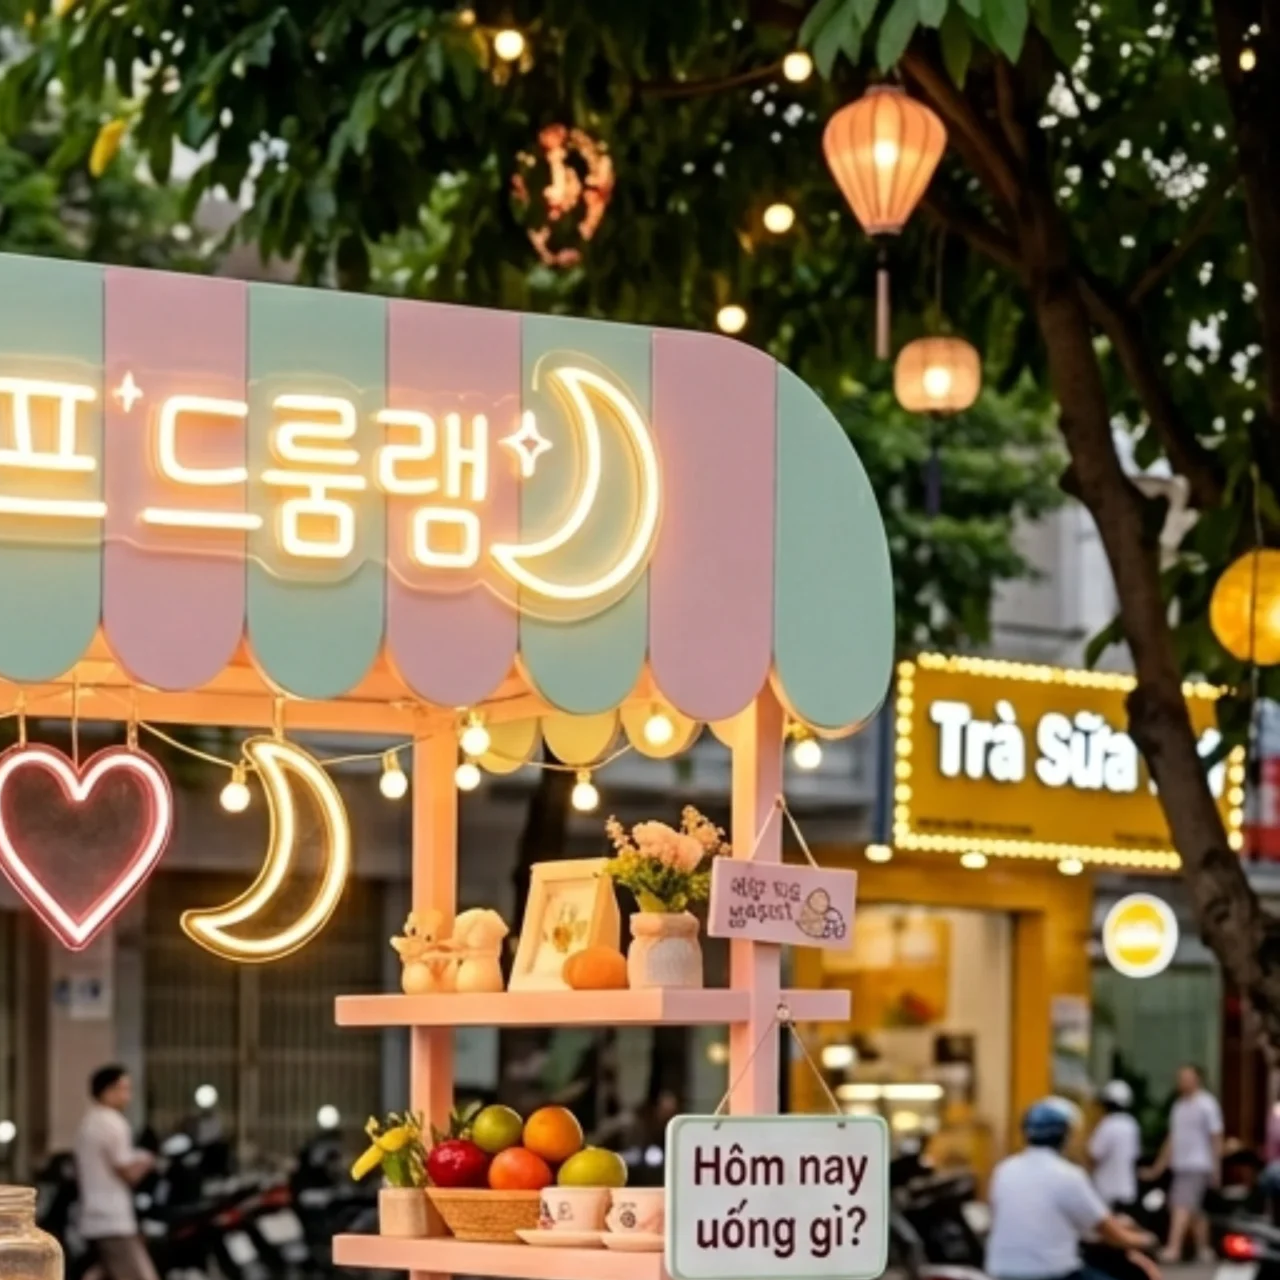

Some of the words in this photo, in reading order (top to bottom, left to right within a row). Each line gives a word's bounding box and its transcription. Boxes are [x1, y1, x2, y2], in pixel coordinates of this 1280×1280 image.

[929, 699, 1026, 783] Trà
[1034, 709, 1139, 793] Sữa
[693, 1142, 785, 1187] Hôm
[798, 1154, 870, 1196] nay
[695, 1197, 798, 1259] uống
[808, 1203, 869, 1259] gì?
